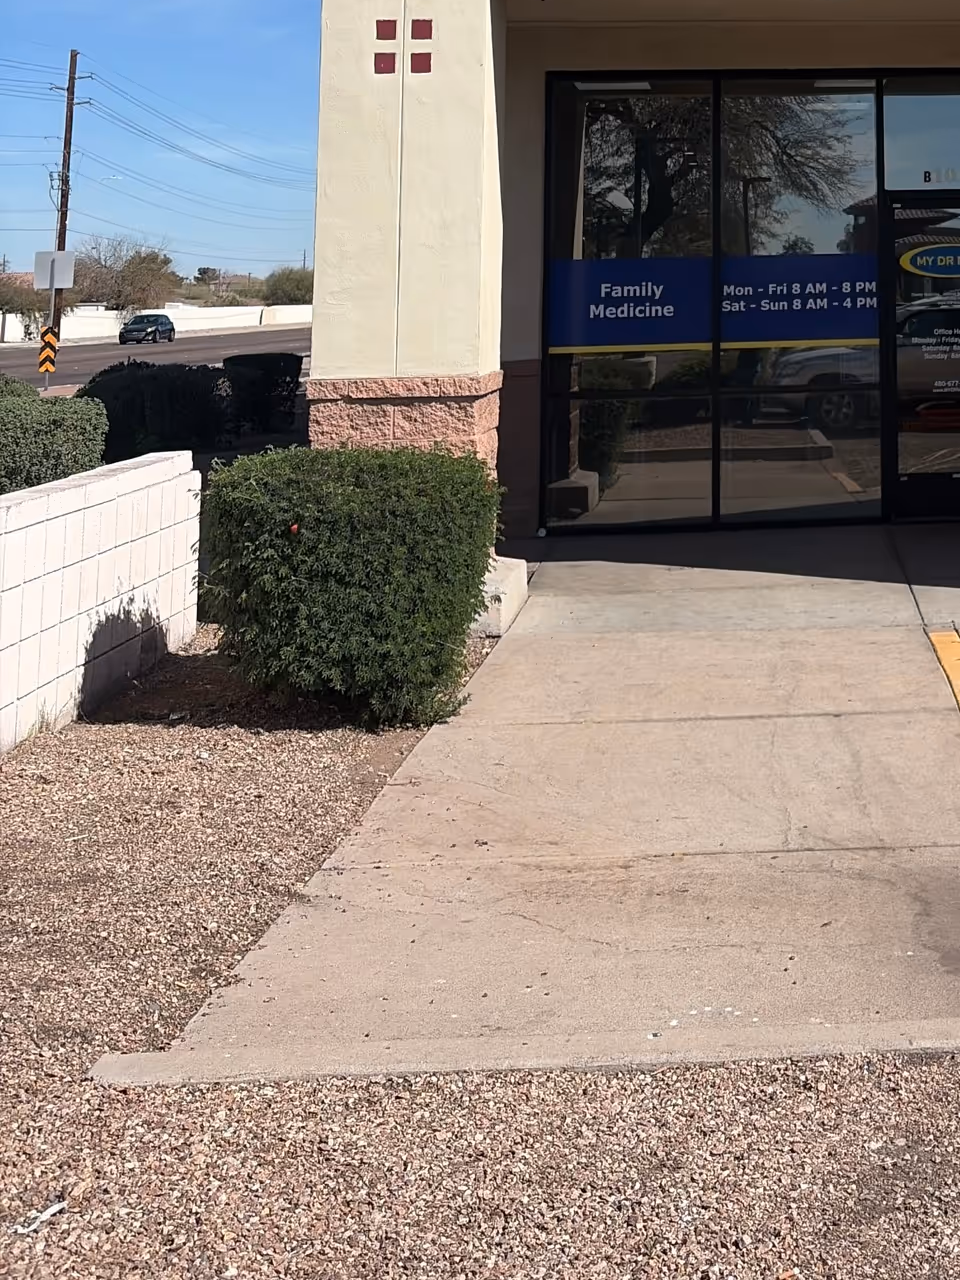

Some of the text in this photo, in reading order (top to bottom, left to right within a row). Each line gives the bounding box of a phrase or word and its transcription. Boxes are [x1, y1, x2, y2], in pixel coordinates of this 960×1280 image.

[916, 256, 934, 266] MY
[937, 256, 954, 266] DR
[600, 282, 664, 300] Family
[723, 284, 753, 296] Mon
[769, 283, 787, 295] Fri
[792, 283, 800, 295] 8
[805, 283, 828, 295] AM
[842, 282, 851, 294] 8
[856, 281, 877, 293] PM
[589, 302, 675, 319] Medicine
[722, 300, 746, 312] Sat
[760, 299, 788, 311] Sun
[792, 298, 802, 311] 8
[806, 298, 828, 310] AM
[842, 297, 852, 309] 4
[856, 297, 878, 309] PM
